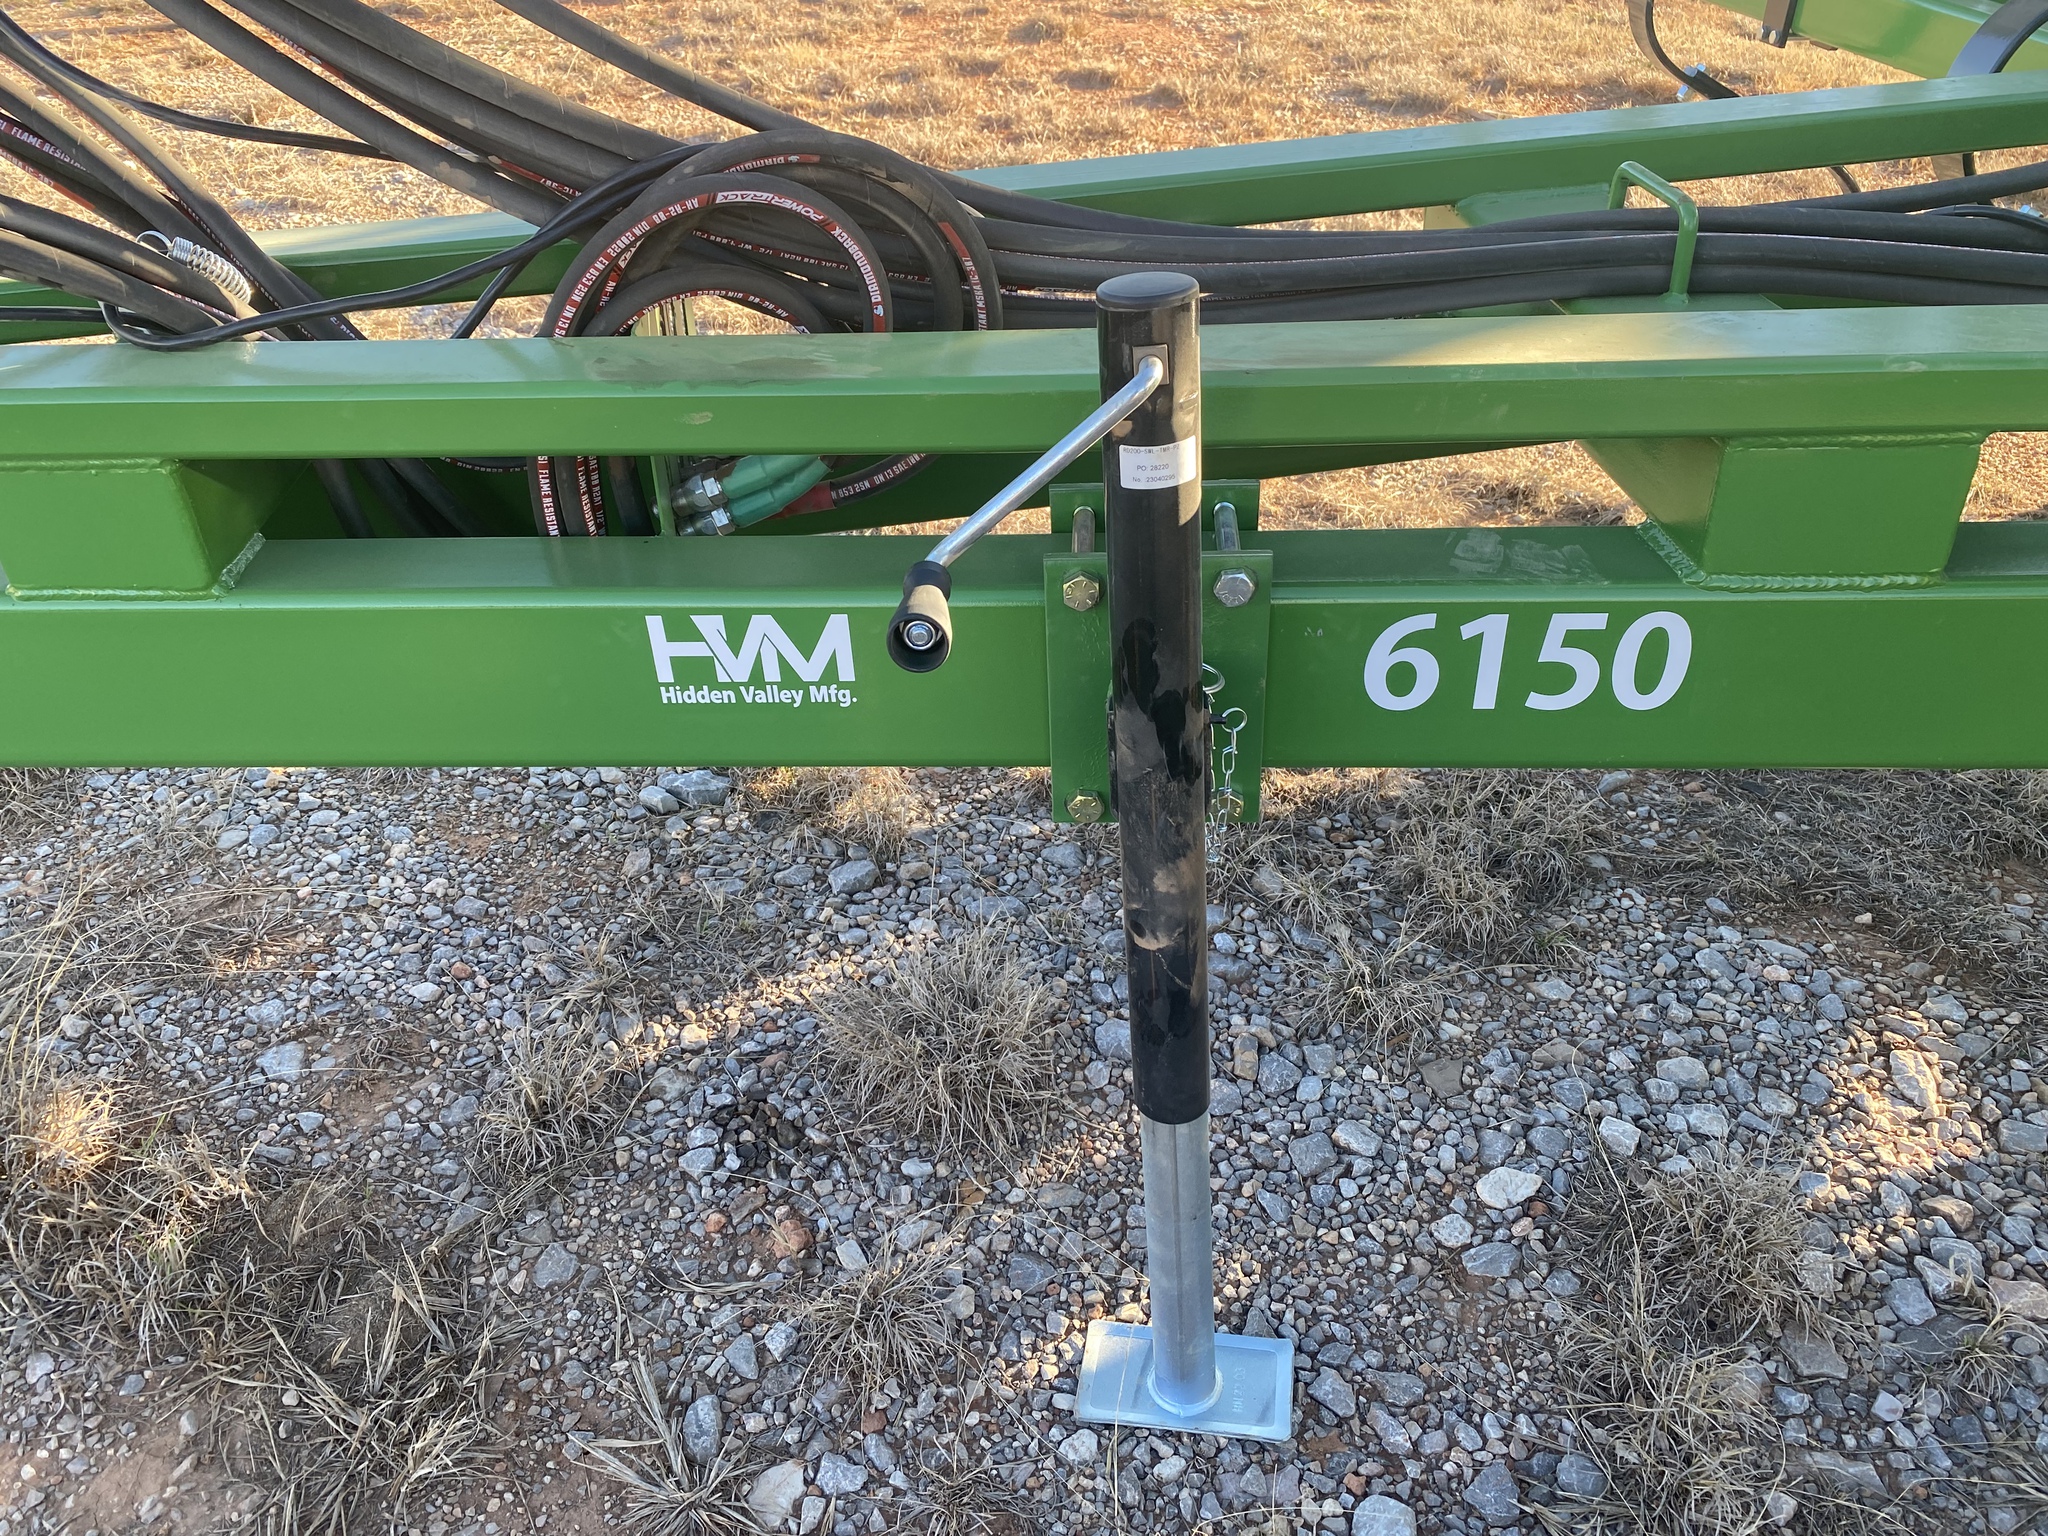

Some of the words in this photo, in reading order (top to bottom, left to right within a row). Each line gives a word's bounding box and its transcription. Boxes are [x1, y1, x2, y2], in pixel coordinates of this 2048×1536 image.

[11, 125, 44, 148] FLAME
[716, 190, 825, 222] POWERTRACK
[632, 220, 651, 238] DIN
[582, 266, 600, 288] 853
[594, 256, 609, 273] EN
[830, 225, 882, 303] DIAMONDBACK
[570, 284, 589, 303] 2SN
[972, 283, 987, 309] MSHA
[562, 305, 577, 321] DN
[577, 466, 588, 493] FLAME
[839, 485, 854, 498] 853
[855, 480, 870, 493] 2SN
[873, 473, 885, 484] DN
[885, 469, 894, 480] 13
[893, 460, 909, 475] SAE
[1150, 463, 1170, 471] 28220
[538, 469, 552, 497] FLAME
[541, 497, 561, 538] RESISTAN
[581, 492, 597, 537] RESISTANT
[645, 614, 855, 682] HVM
[1363, 610, 1693, 712] 6150
[660, 684, 736, 704] Hidden
[739, 684, 803, 707] Valley
[809, 684, 858, 707] Mfg.
